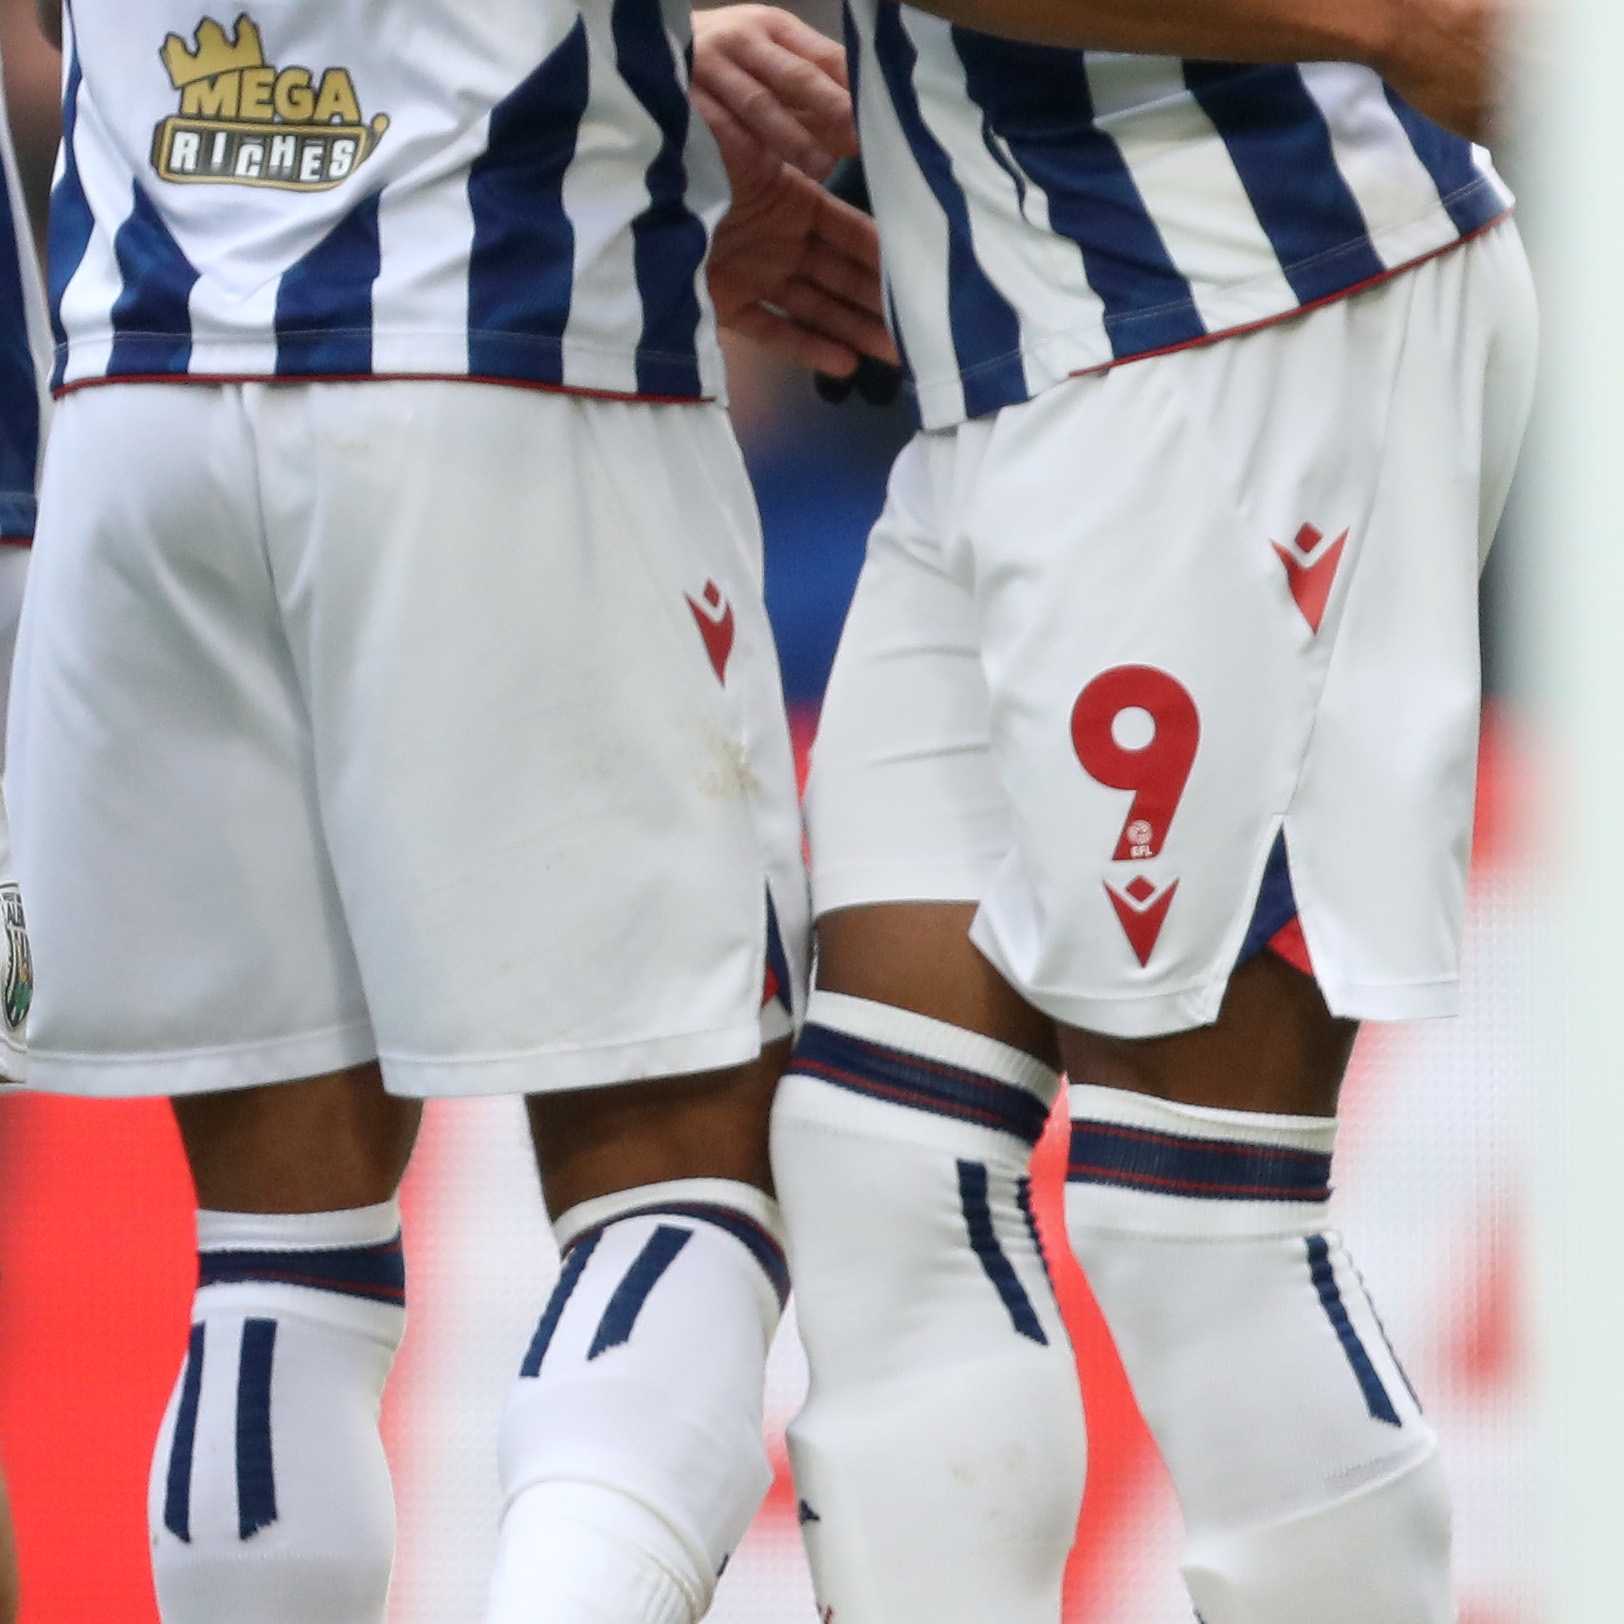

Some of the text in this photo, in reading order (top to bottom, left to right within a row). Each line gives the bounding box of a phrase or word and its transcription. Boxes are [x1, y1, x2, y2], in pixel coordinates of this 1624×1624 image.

[178, 64, 362, 124] MEGA
[169, 130, 357, 183] RICHES
[1070, 663, 1201, 861] 9
